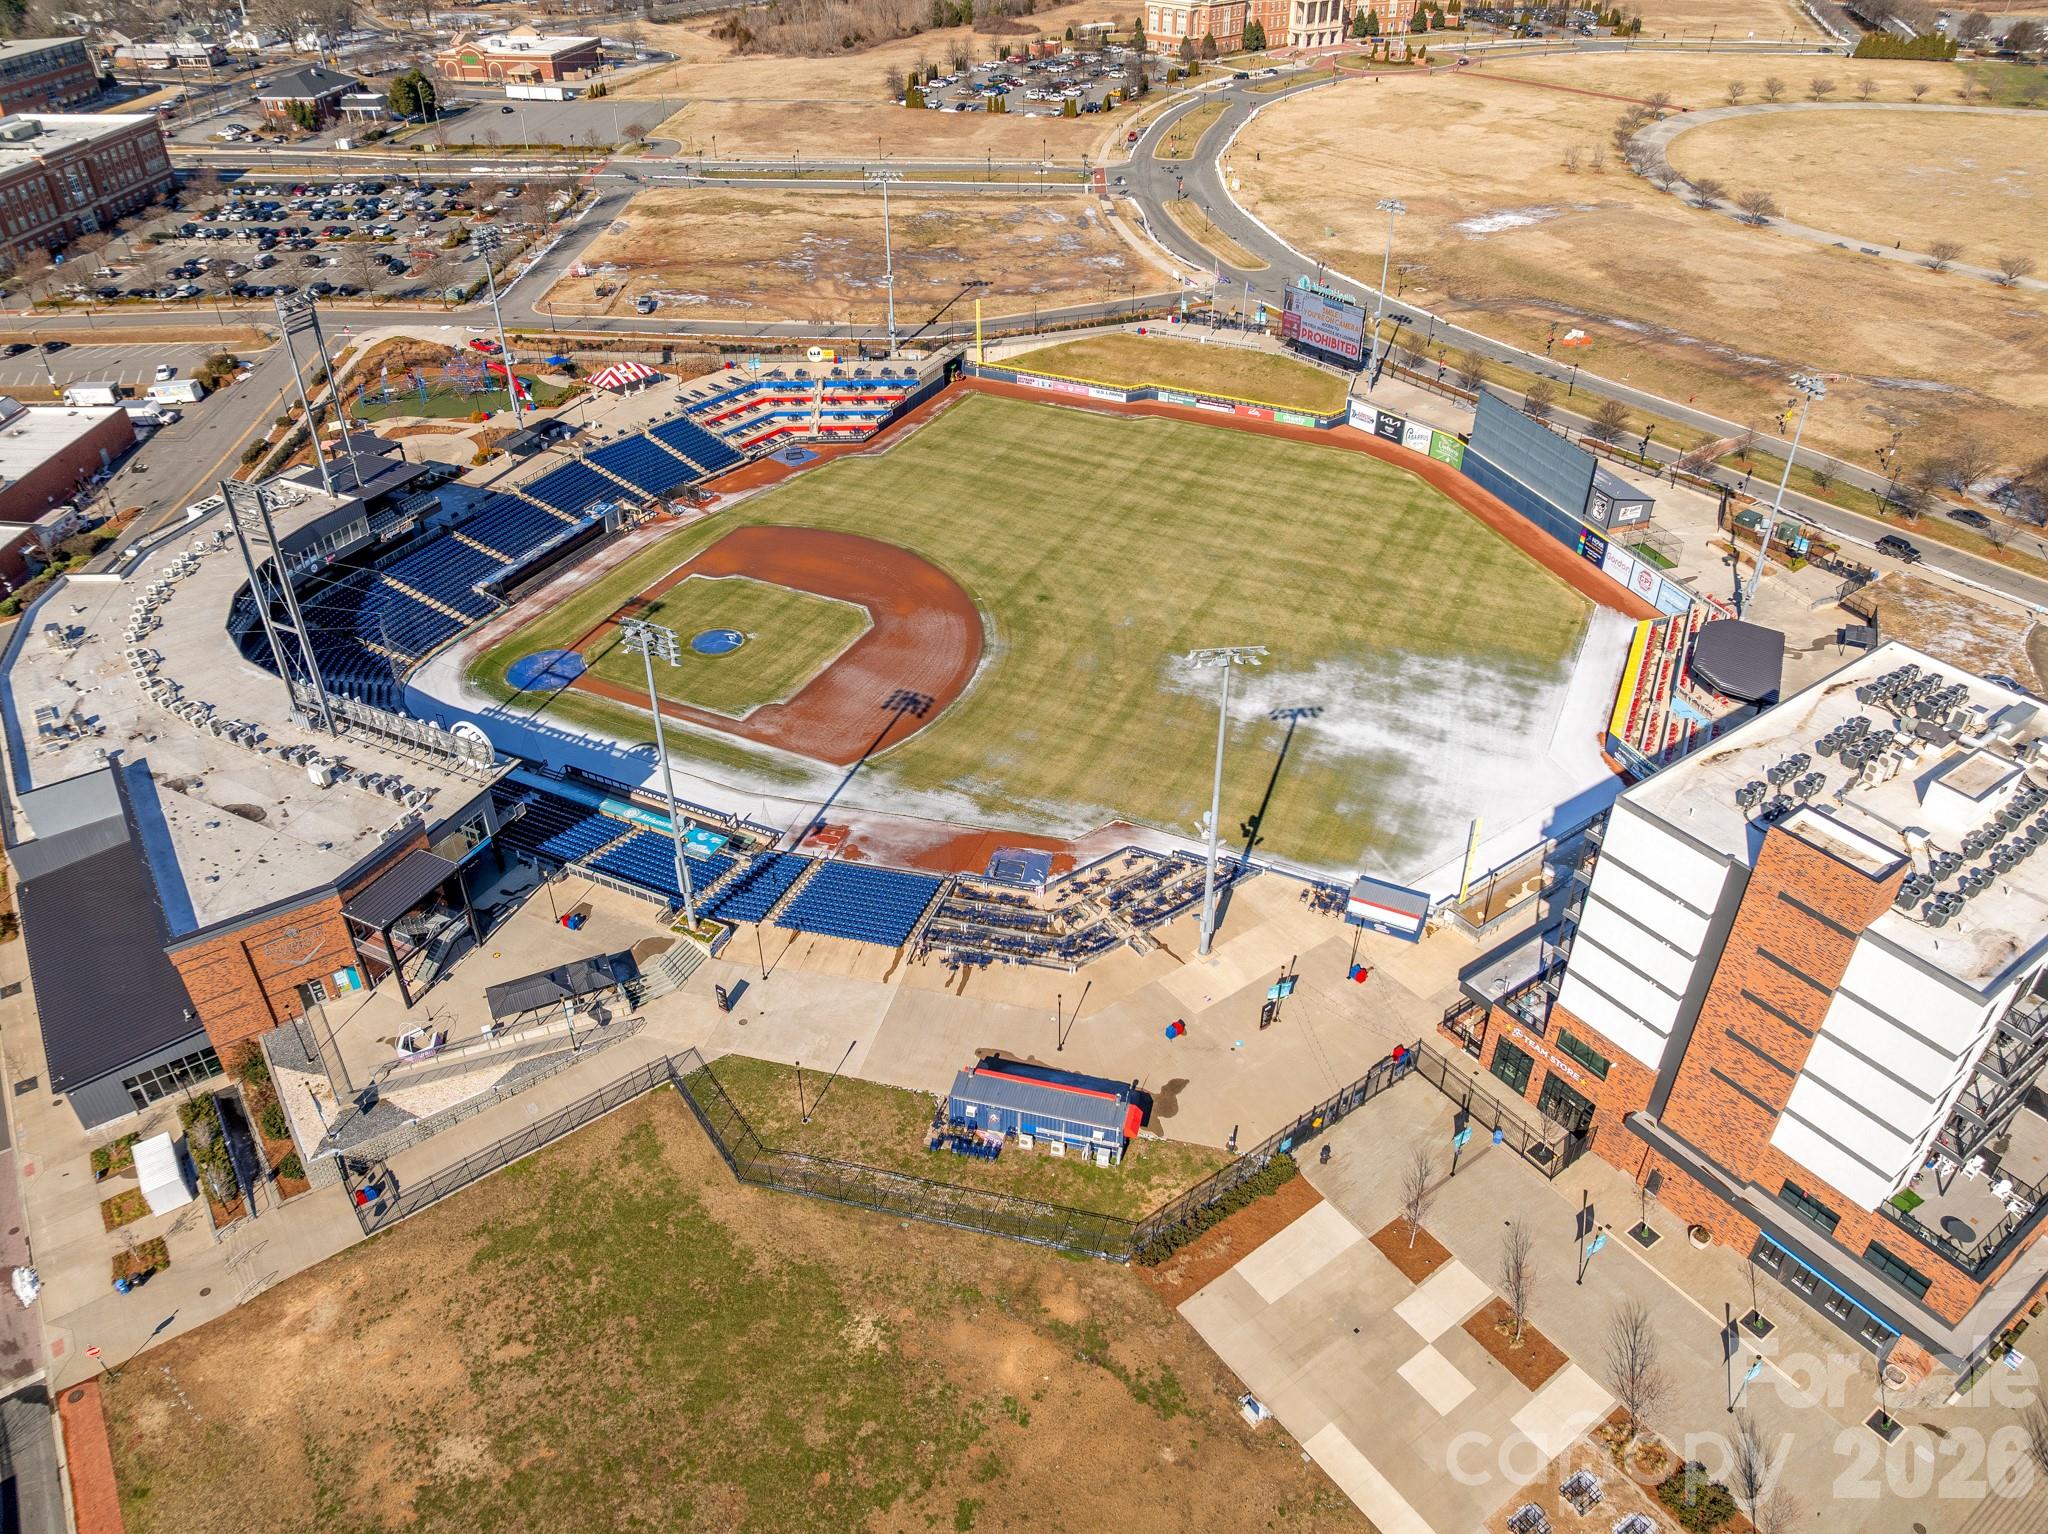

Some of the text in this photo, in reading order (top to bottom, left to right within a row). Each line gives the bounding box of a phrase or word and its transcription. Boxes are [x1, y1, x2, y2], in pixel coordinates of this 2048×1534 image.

[1301, 327, 1358, 355] PROHIBITED
[1523, 1036, 1581, 1081] TEAM STORE
